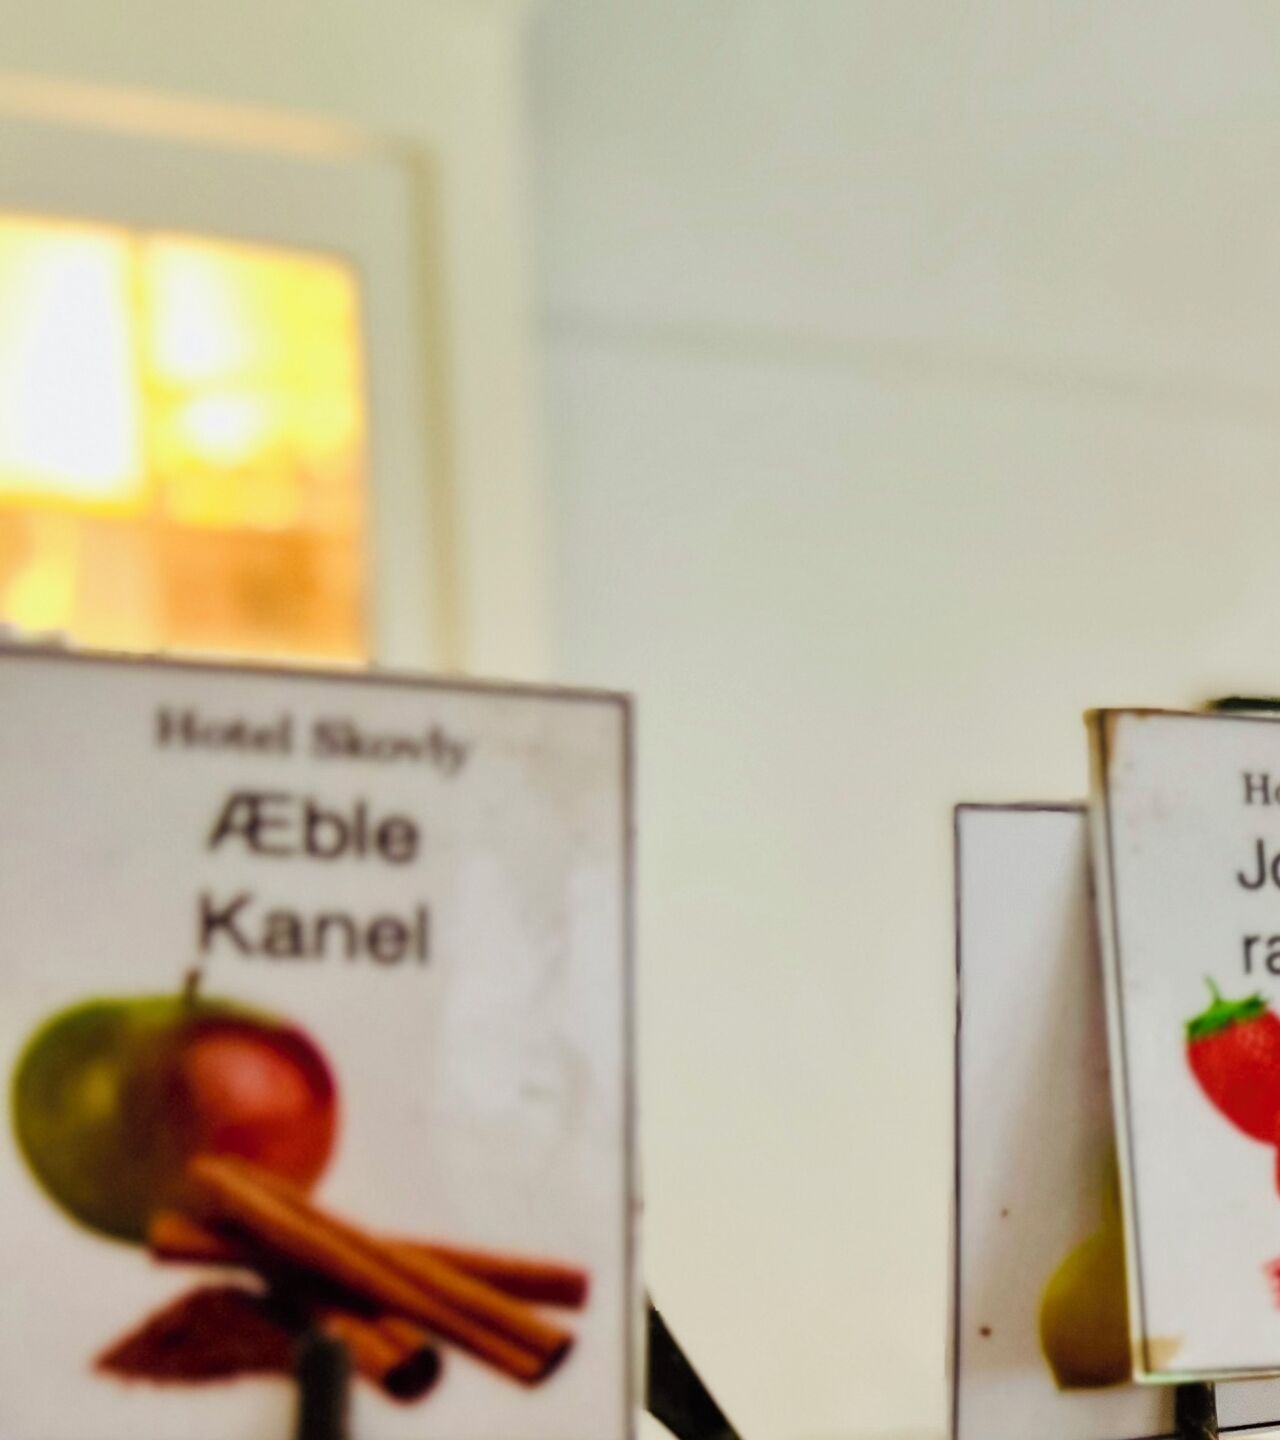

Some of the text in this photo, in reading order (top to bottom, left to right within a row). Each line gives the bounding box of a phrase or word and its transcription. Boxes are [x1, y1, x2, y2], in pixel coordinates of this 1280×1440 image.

[156, 708, 472, 776] Hotel Skovly
[208, 790, 420, 865] Æble
[198, 894, 430, 965] Kanel
